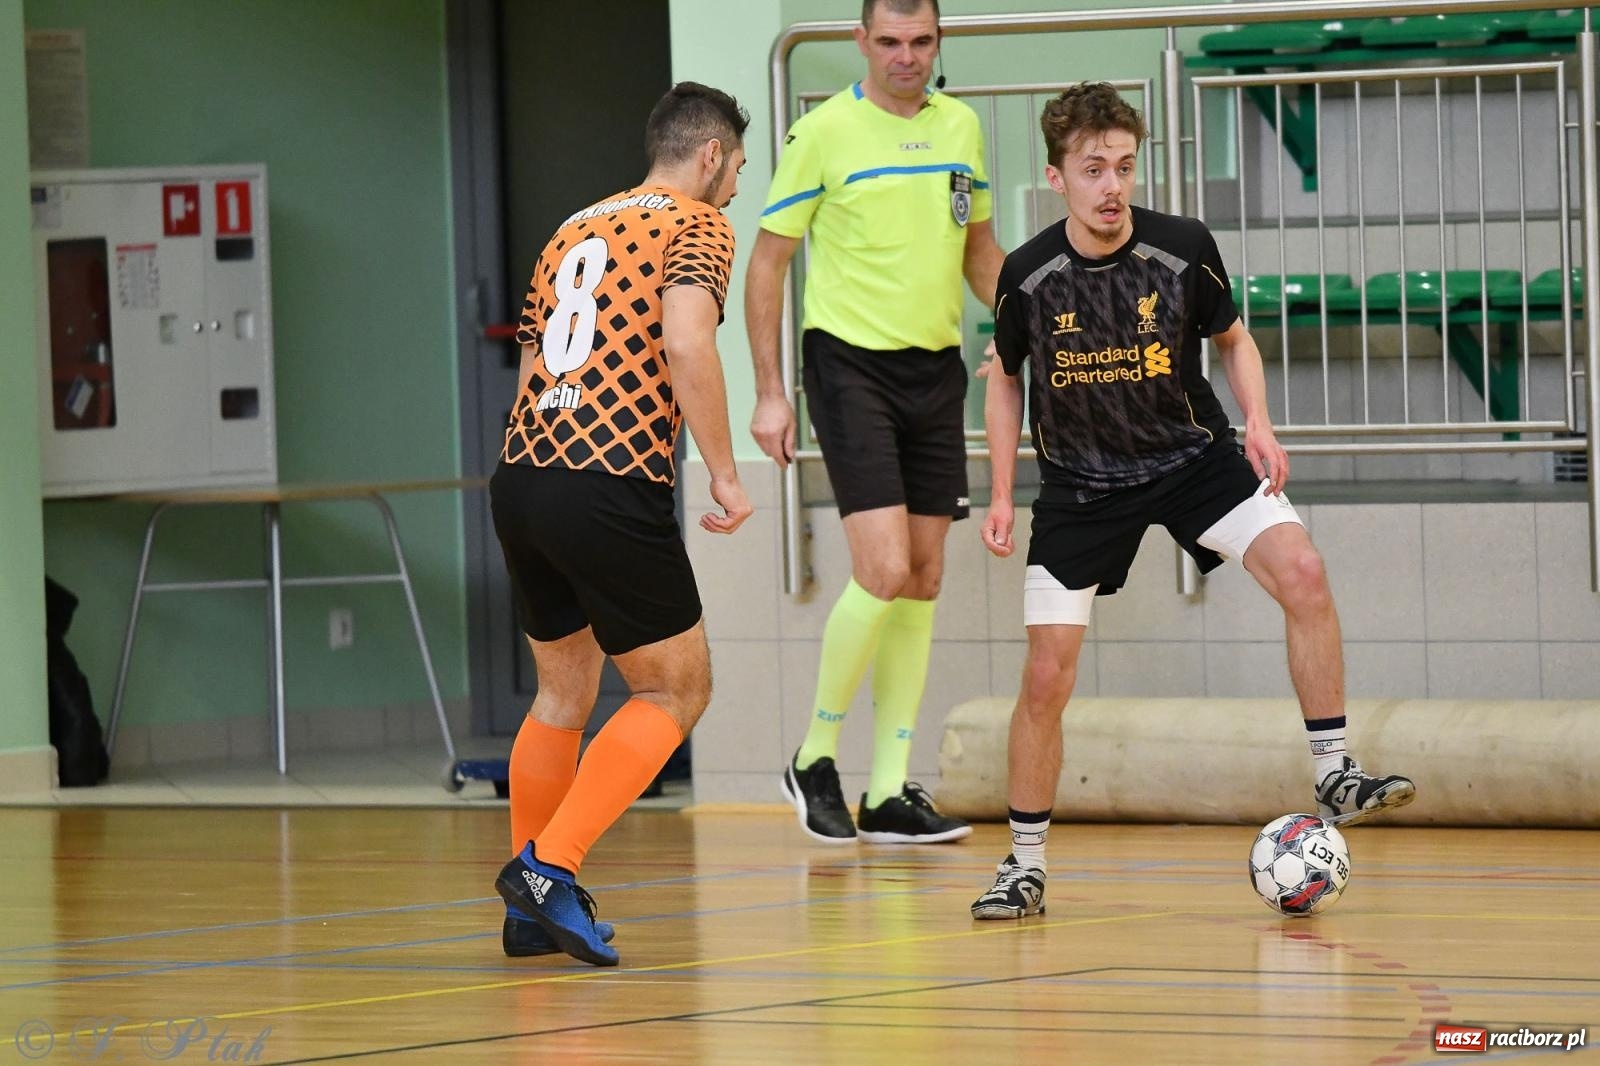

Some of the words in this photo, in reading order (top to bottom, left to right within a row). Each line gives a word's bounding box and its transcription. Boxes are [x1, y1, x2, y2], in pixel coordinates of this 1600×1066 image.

[542, 236, 609, 379] 8
[1055, 344, 1140, 368] Standard
[1051, 365, 1142, 388] Chartered
[1308, 842, 1348, 881] SELECT
[521, 870, 545, 905] adidas
